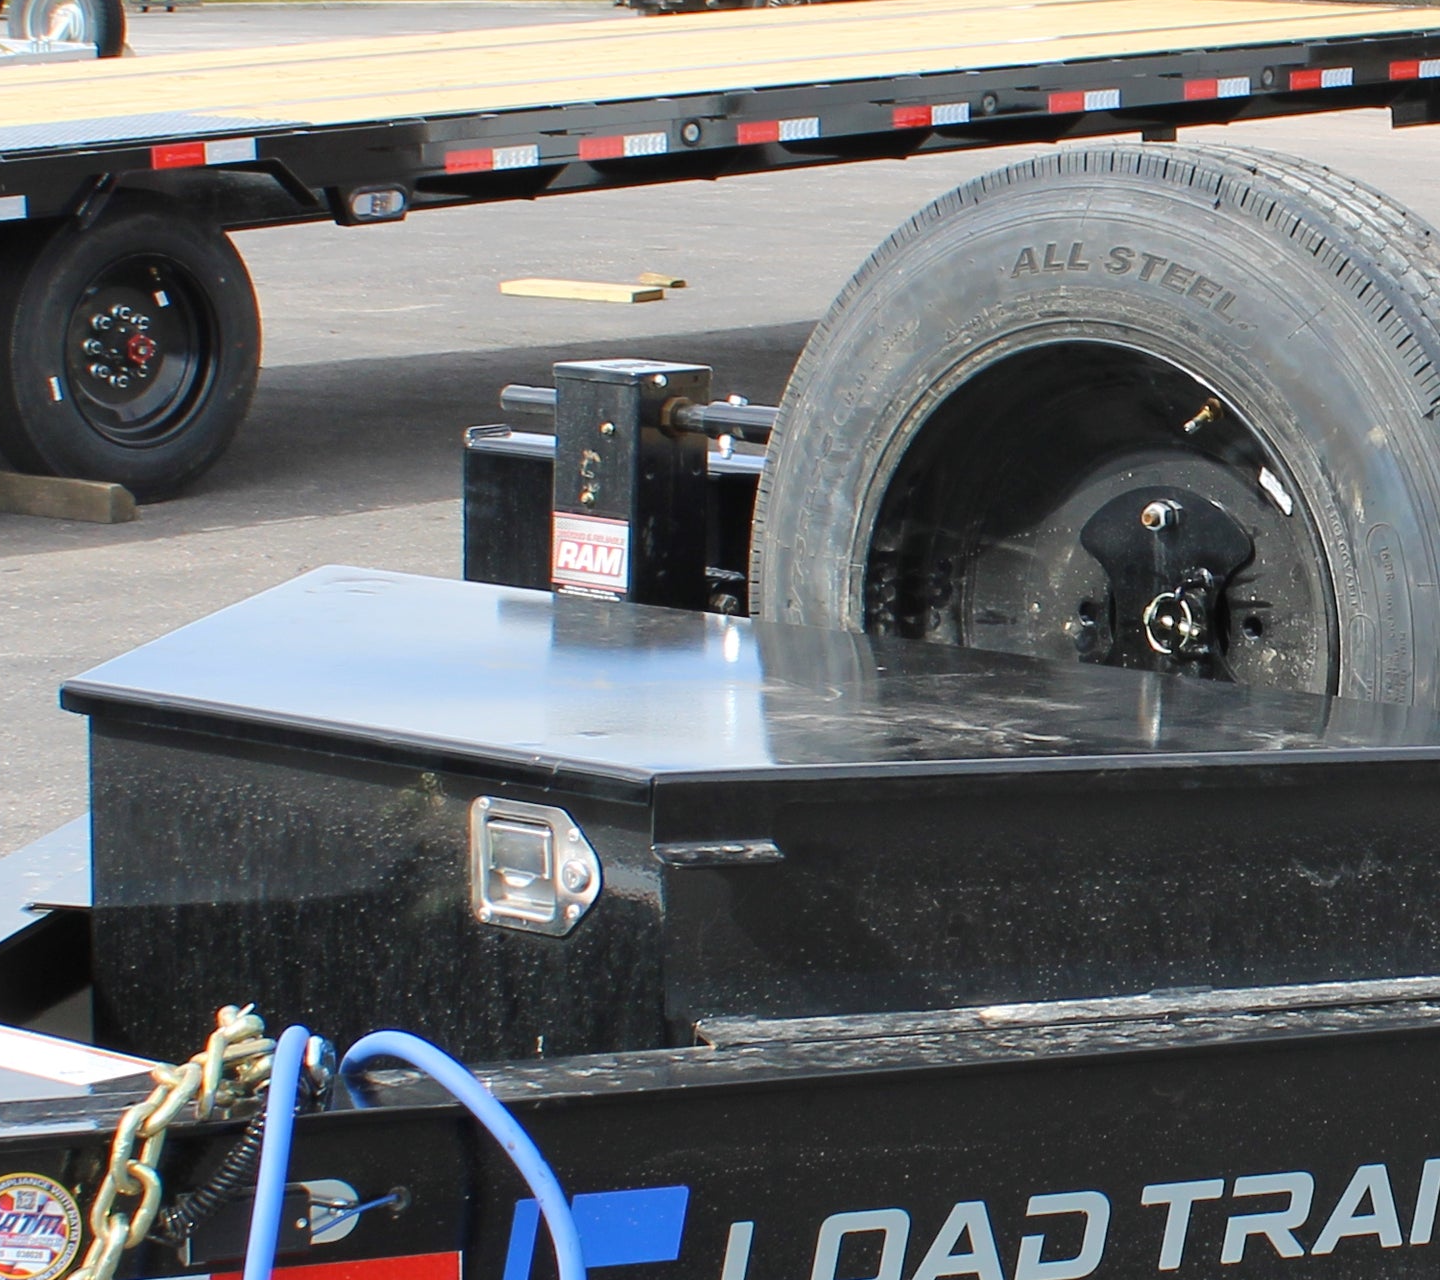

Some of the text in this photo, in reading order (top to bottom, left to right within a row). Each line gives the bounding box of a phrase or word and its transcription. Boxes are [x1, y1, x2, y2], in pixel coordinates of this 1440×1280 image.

[1010, 241, 1238, 323] ALL STEEL
[557, 540, 624, 576] RAM
[48, 1186, 73, 1212] WITH
[63, 1210, 79, 1242] NATM
